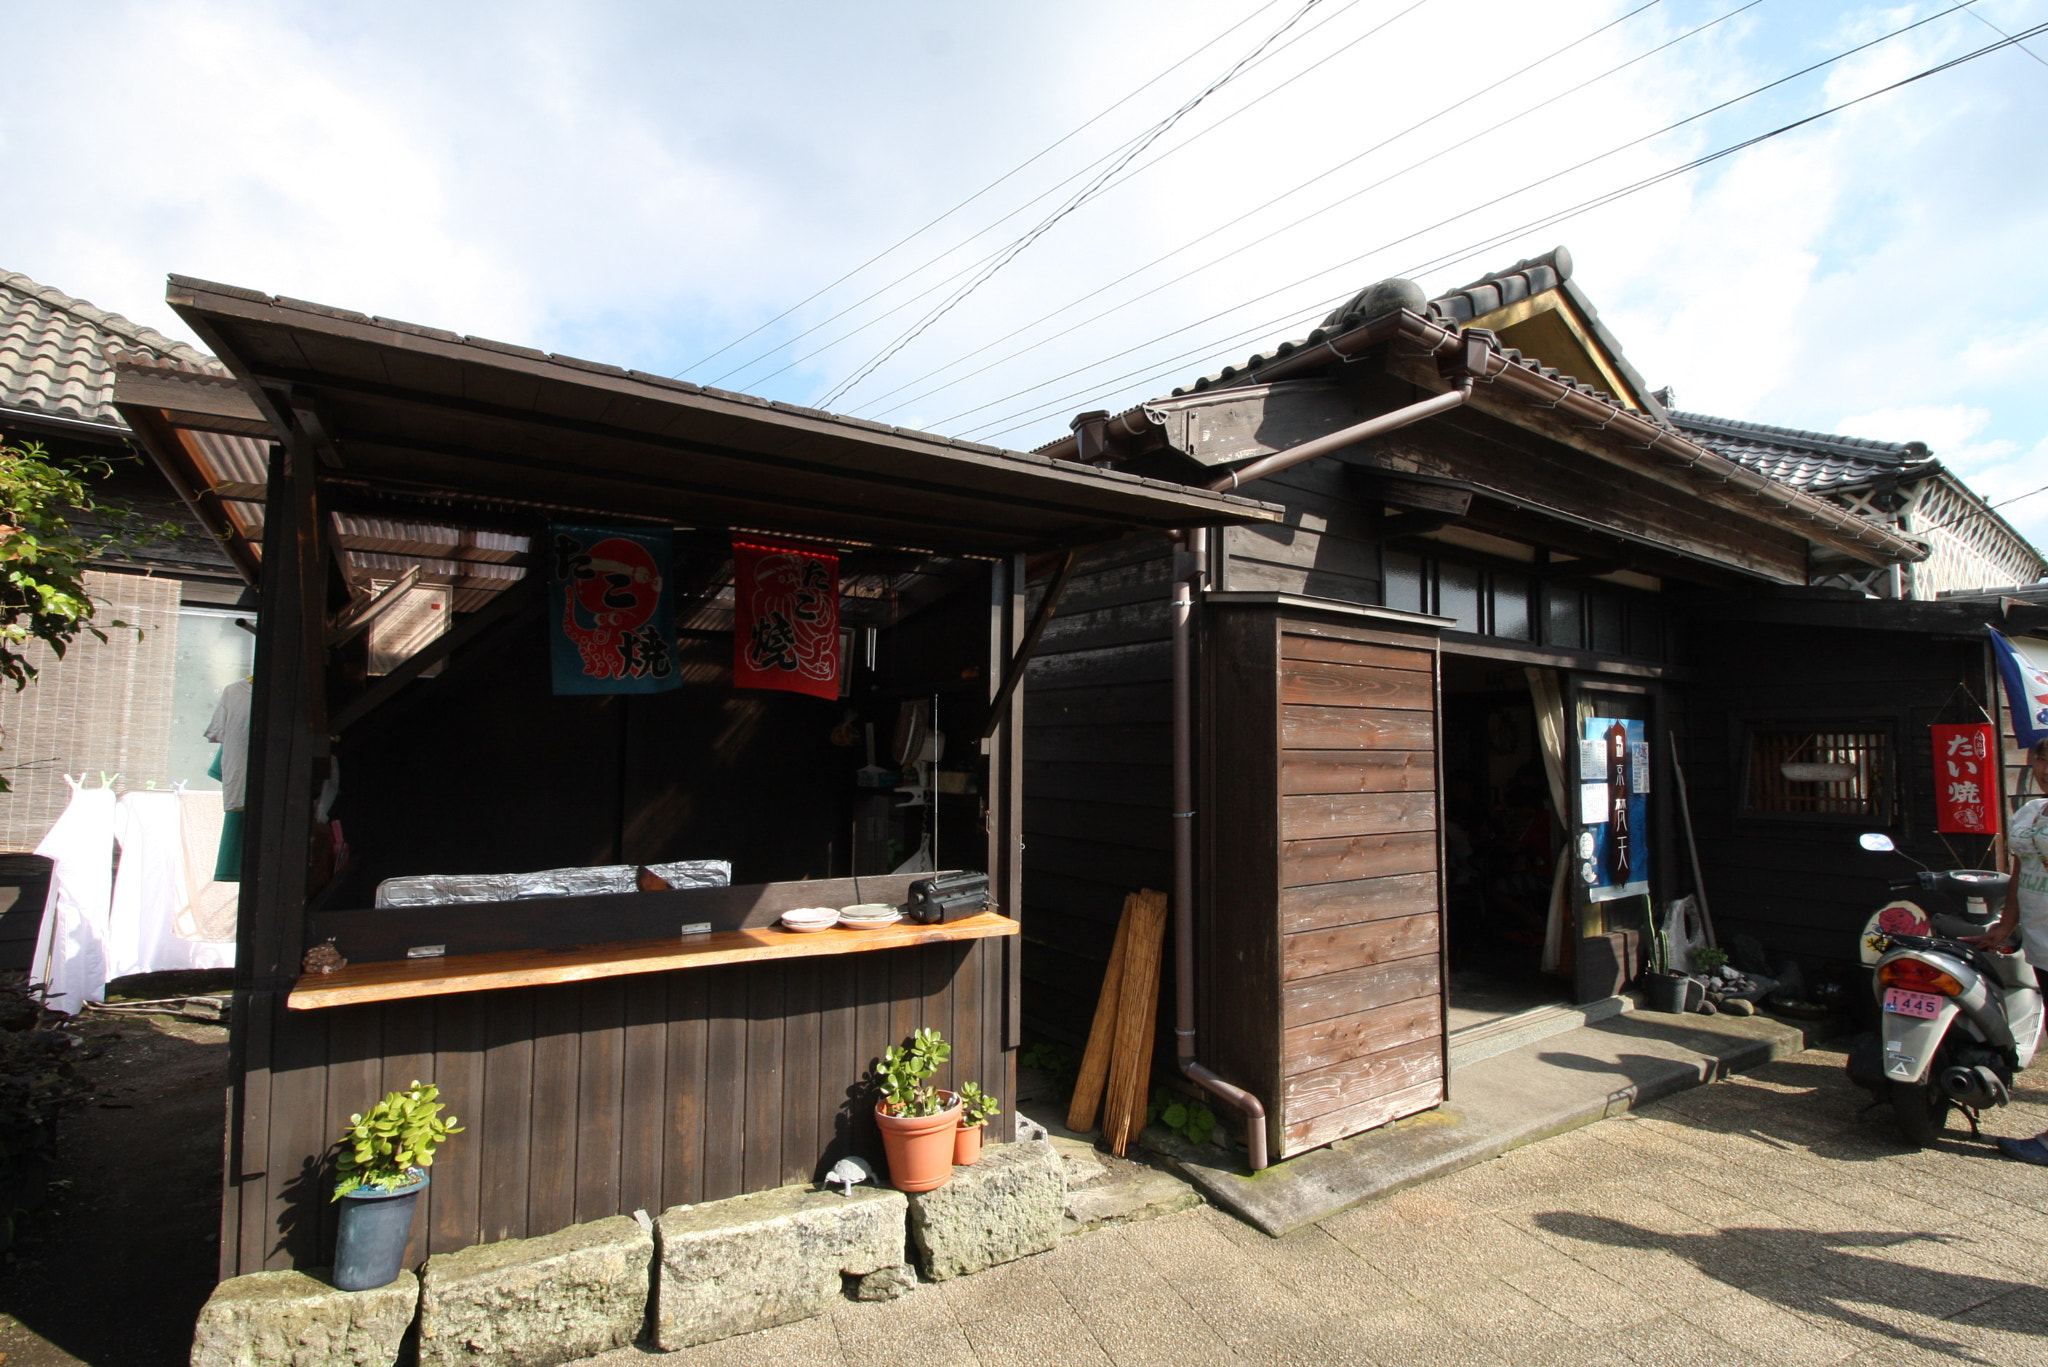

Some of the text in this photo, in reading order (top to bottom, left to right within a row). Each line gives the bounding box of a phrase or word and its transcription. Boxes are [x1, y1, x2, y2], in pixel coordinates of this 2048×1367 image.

[553, 533, 672, 679] たこ焼
[751, 558, 831, 672] たこ焼
[1946, 734, 1981, 804] たい焼
